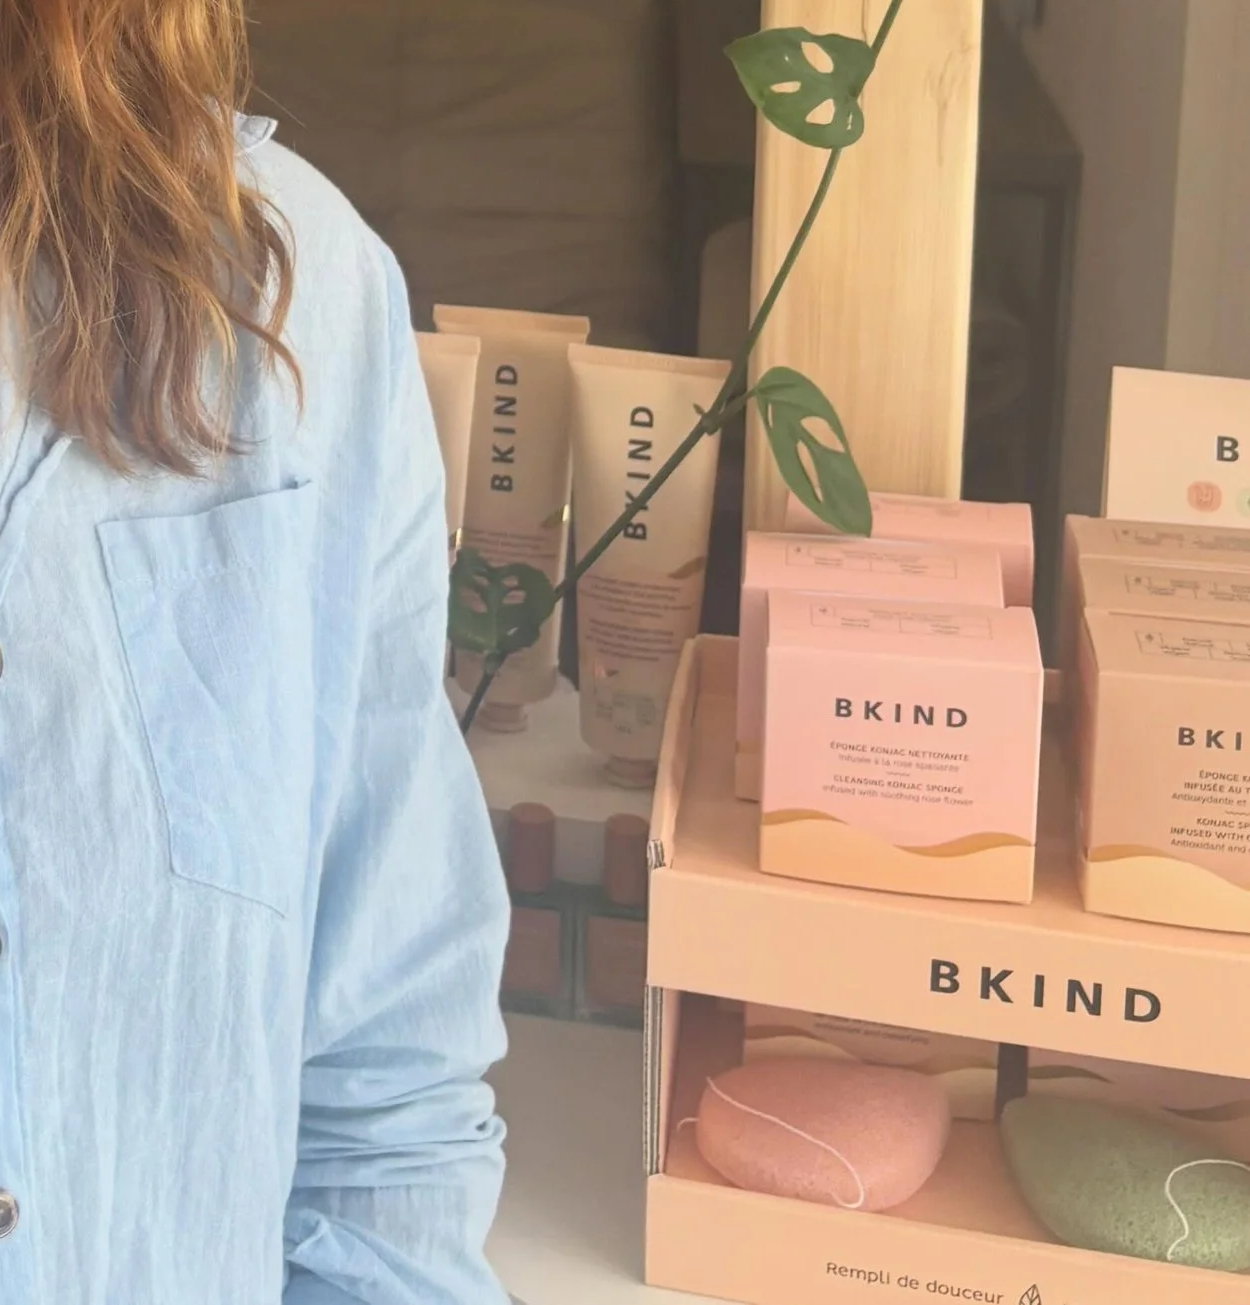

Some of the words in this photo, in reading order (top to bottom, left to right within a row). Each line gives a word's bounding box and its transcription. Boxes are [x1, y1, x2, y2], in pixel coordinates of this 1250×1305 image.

[490, 363, 518, 493] BKIND
[1216, 436, 1240, 462] B
[835, 697, 968, 727] BKIND
[830, 740, 867, 752] ÉPONGE
[871, 746, 906, 756] KONJAC
[908, 750, 970, 762] NETTOYANTE
[833, 775, 884, 787] CLEANSING
[887, 780, 922, 790] KONJAC
[925, 784, 964, 795] SPONGE
[1199, 769, 1239, 782] ÉPONGE
[1184, 781, 1225, 794] INFUSÉE
[1228, 786, 1242, 795] AU
[1170, 826, 1211, 838] INFUSED
[1215, 830, 1244, 842] WITH
[1196, 817, 1234, 829] KONJAC
[929, 958, 1162, 1024] BKIND
[826, 1261, 891, 1285] Rempli
[897, 1273, 920, 1290] de
[926, 1279, 1005, 1305] douceur
